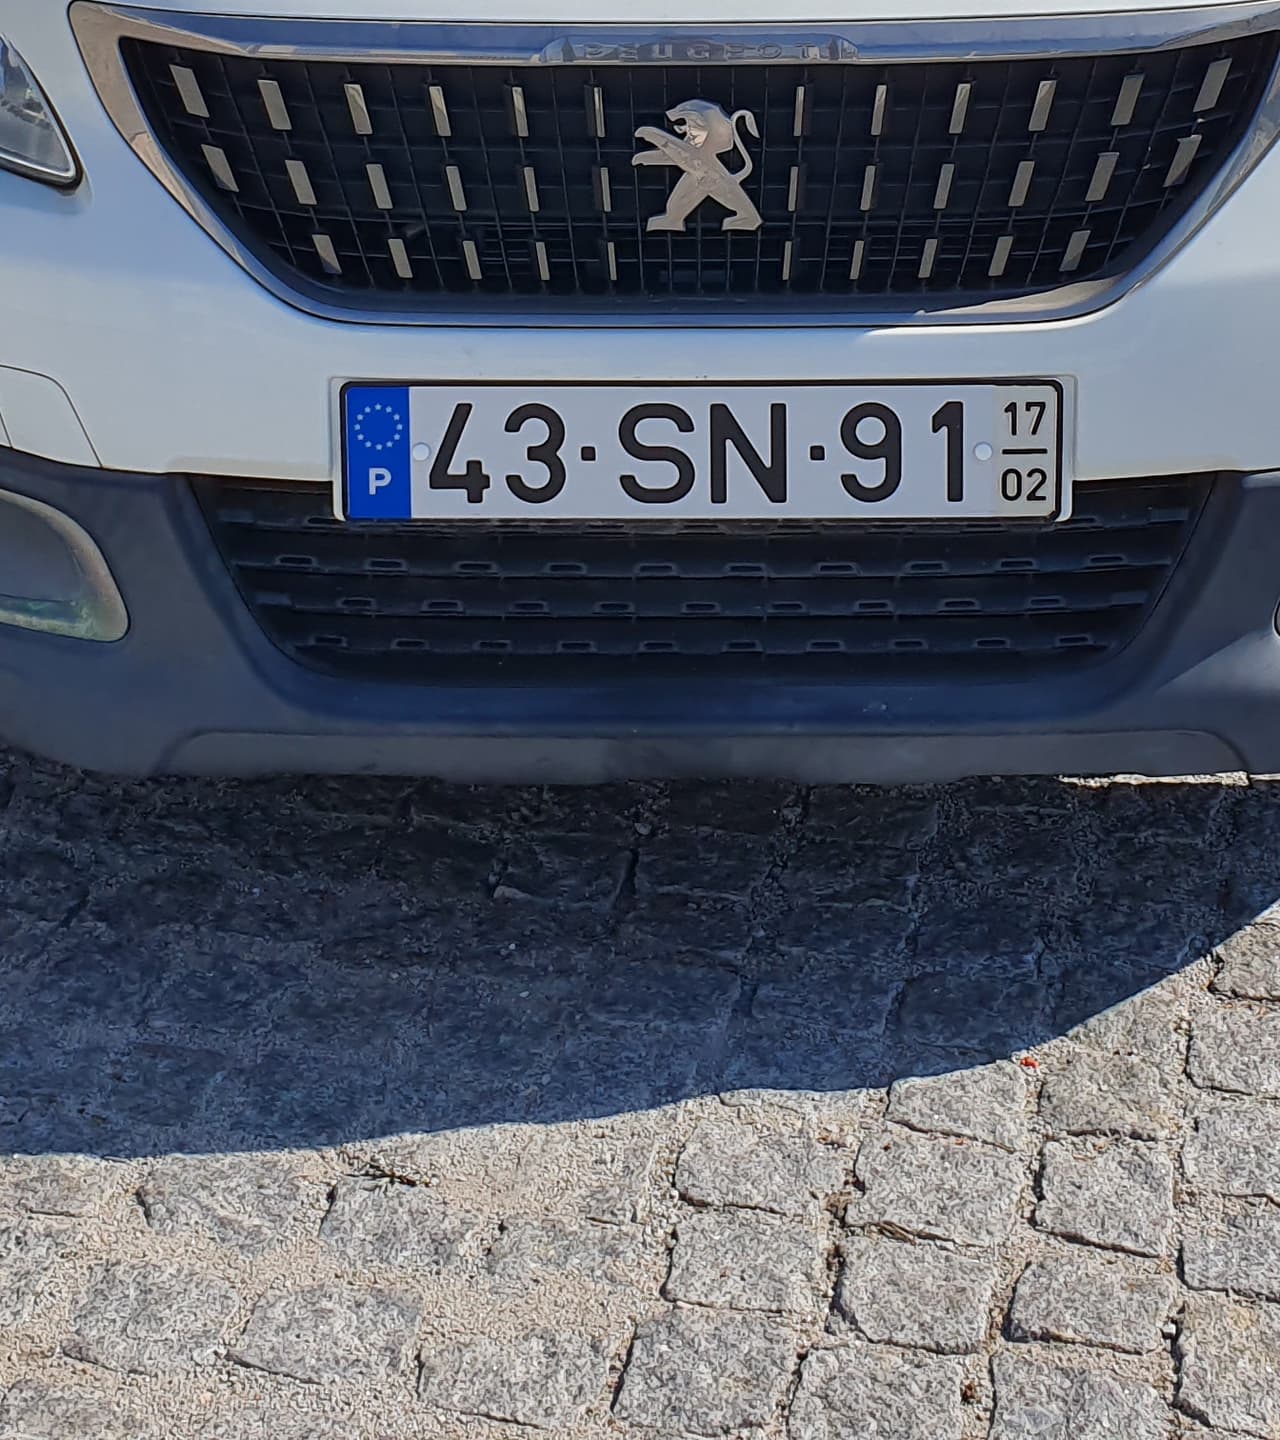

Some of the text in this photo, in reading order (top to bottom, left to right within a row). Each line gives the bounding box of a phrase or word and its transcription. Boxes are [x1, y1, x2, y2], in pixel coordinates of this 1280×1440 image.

[583, 43, 820, 60] PEUGEOT
[1004, 401, 1047, 436] 17
[368, 467, 392, 495] P
[1001, 468, 1048, 502] 02
